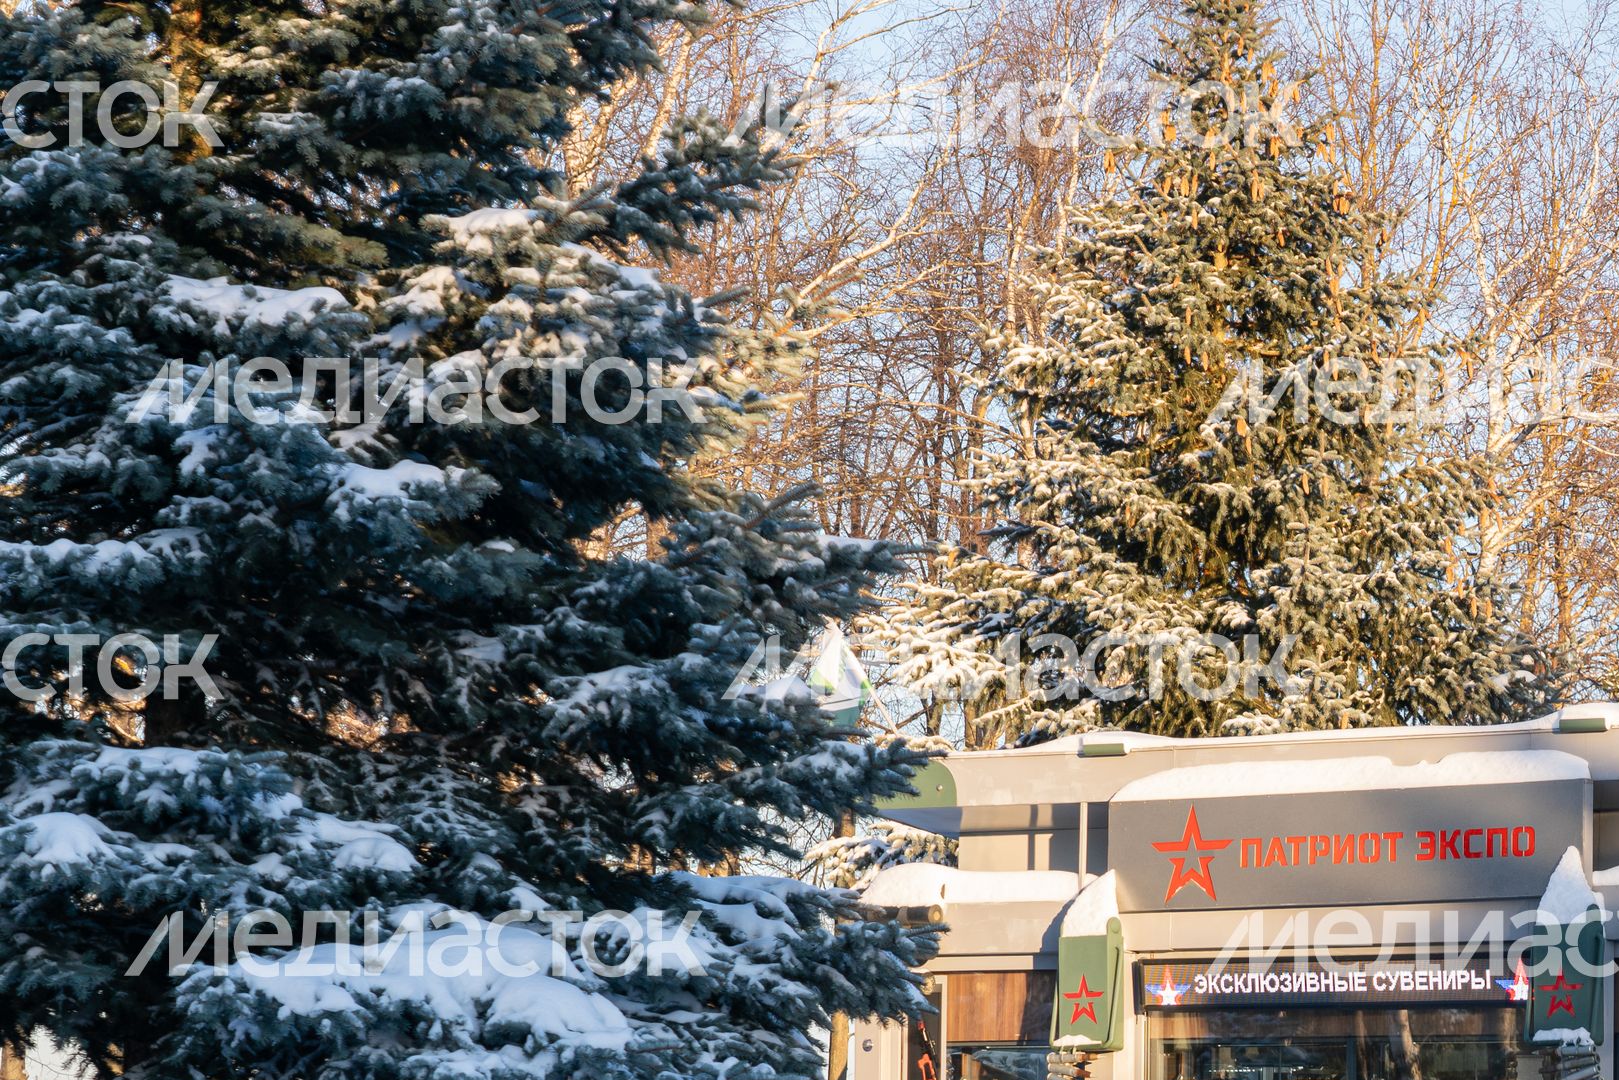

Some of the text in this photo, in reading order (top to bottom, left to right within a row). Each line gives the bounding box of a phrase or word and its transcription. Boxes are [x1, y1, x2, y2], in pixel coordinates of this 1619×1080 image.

[1239, 825, 1537, 868] ПАТРИОТ ЭКСПО
[1193, 968, 1492, 995] ЭКСКЛЮЗИВНЫЕ СУВЕНИРЫ
